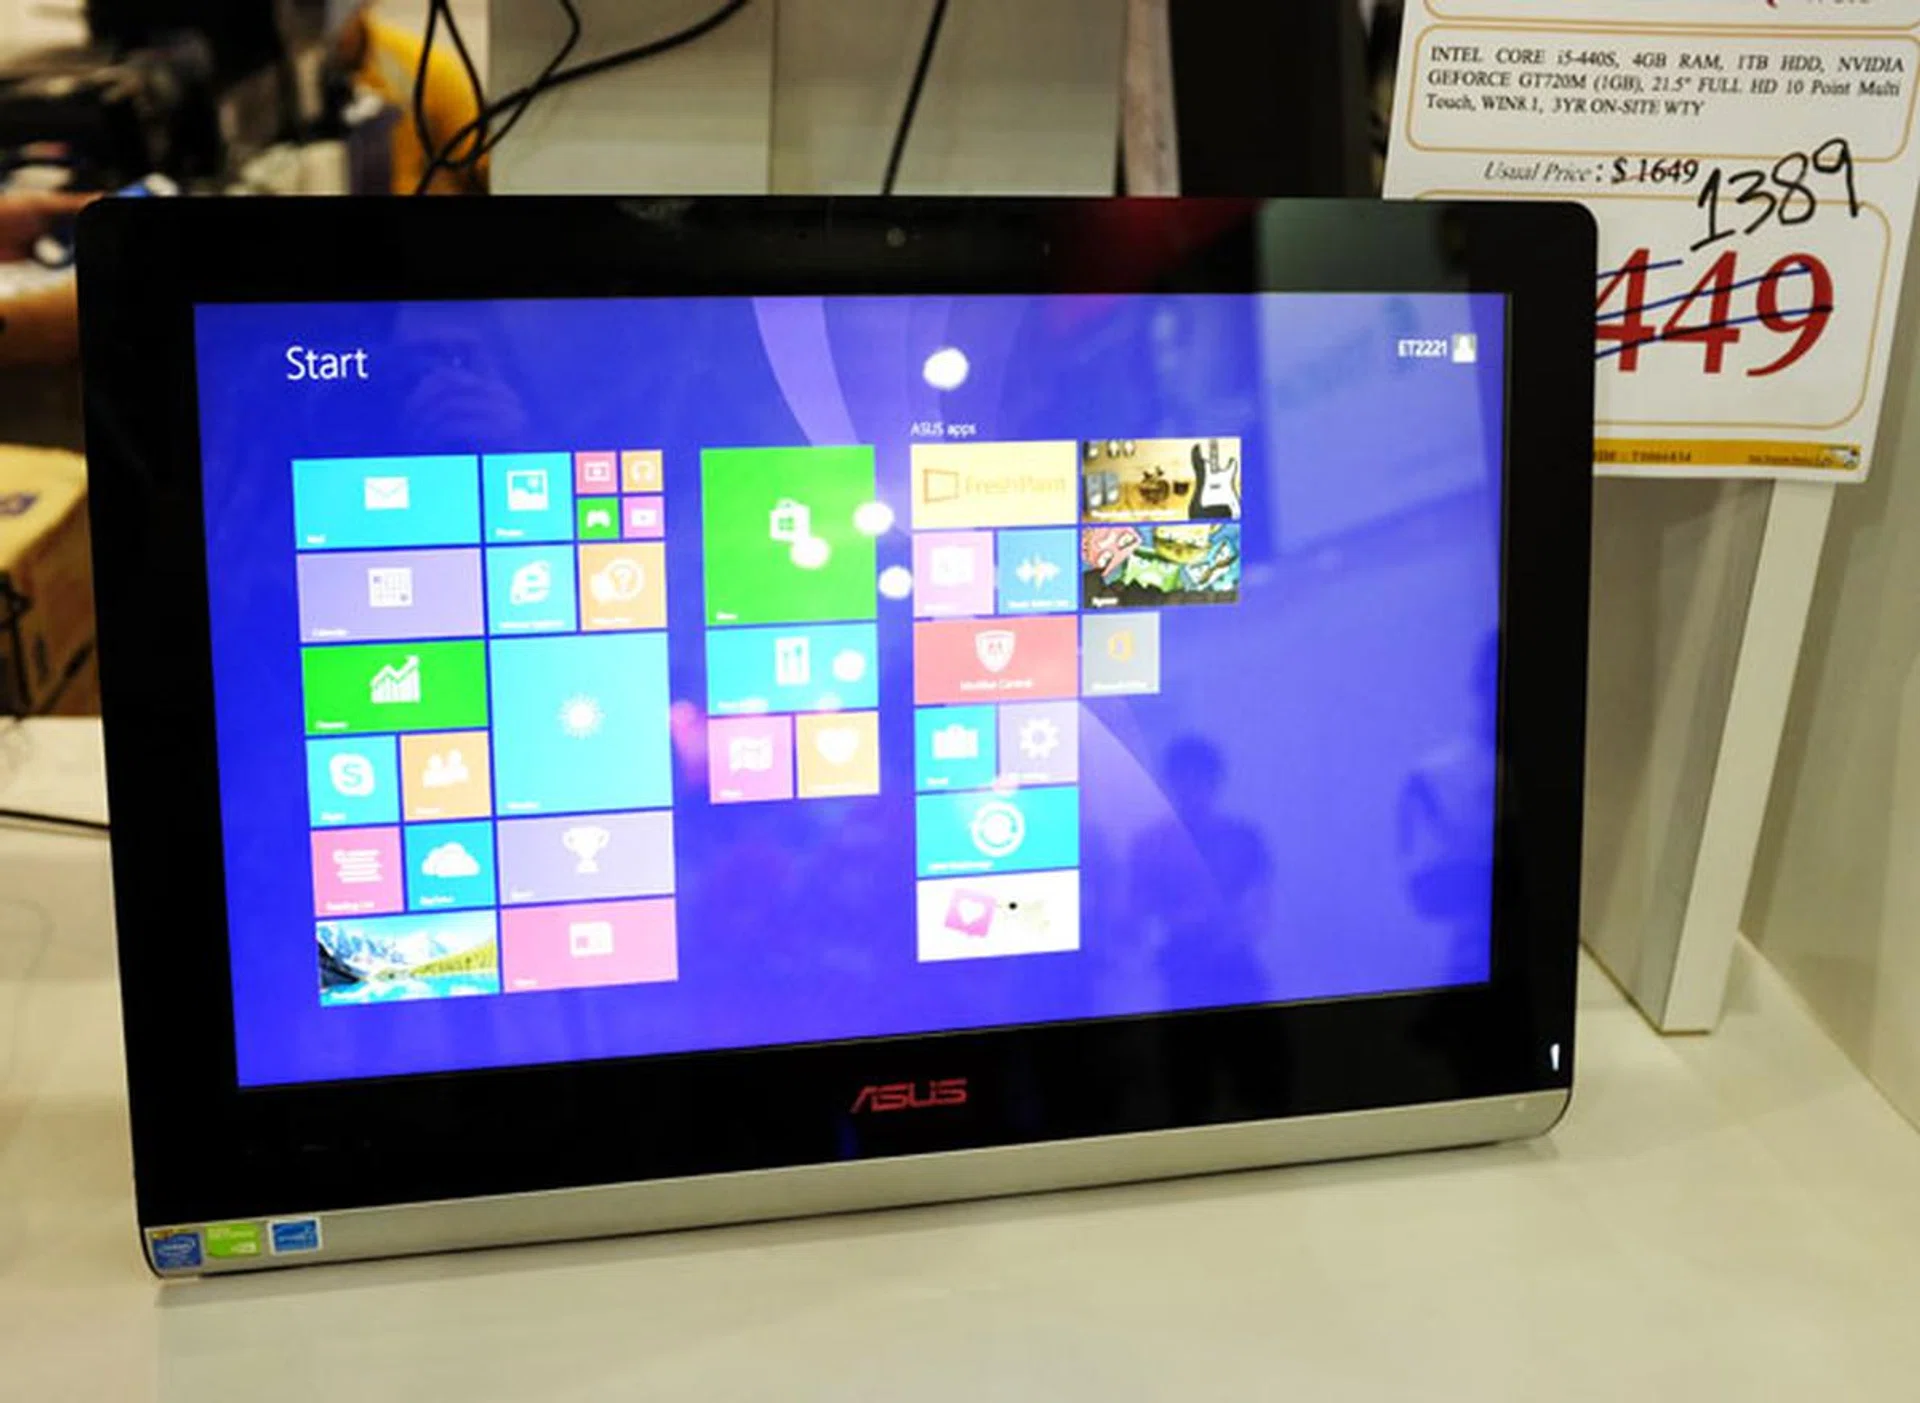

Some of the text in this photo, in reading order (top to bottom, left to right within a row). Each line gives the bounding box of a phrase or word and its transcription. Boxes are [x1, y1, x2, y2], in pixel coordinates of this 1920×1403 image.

[1431, 47, 1482, 62] INTEL
[1495, 48, 1545, 64] CORE
[1632, 51, 1667, 68] 4GB
[1678, 53, 1724, 71] RAM,
[1738, 54, 1769, 70] 1TB
[1780, 55, 1825, 73] HDD,
[1838, 56, 1904, 73] NVIDIA
[1428, 69, 1512, 88] GEFORCE
[1519, 72, 1587, 90] GT720M
[1593, 74, 1645, 94] (1GB),
[1697, 76, 1741, 94] FULL
[1750, 78, 1778, 94] HD
[1786, 78, 1804, 95] 10
[1811, 79, 1851, 96] Point
[1857, 80, 1901, 97] Multi
[1426, 93, 1476, 111] Touch,
[1552, 97, 1588, 113] 3YR
[1590, 98, 1660, 115] ON-SITE
[1664, 100, 1705, 116] WTY
[1484, 160, 1540, 181] Usual
[1690, 138, 1858, 252] 1389
[1398, 339, 1448, 358] ET2221
[286, 345, 369, 380] Start
[910, 422, 977, 438] ASUS apps
[849, 1078, 968, 1114] ASUS
